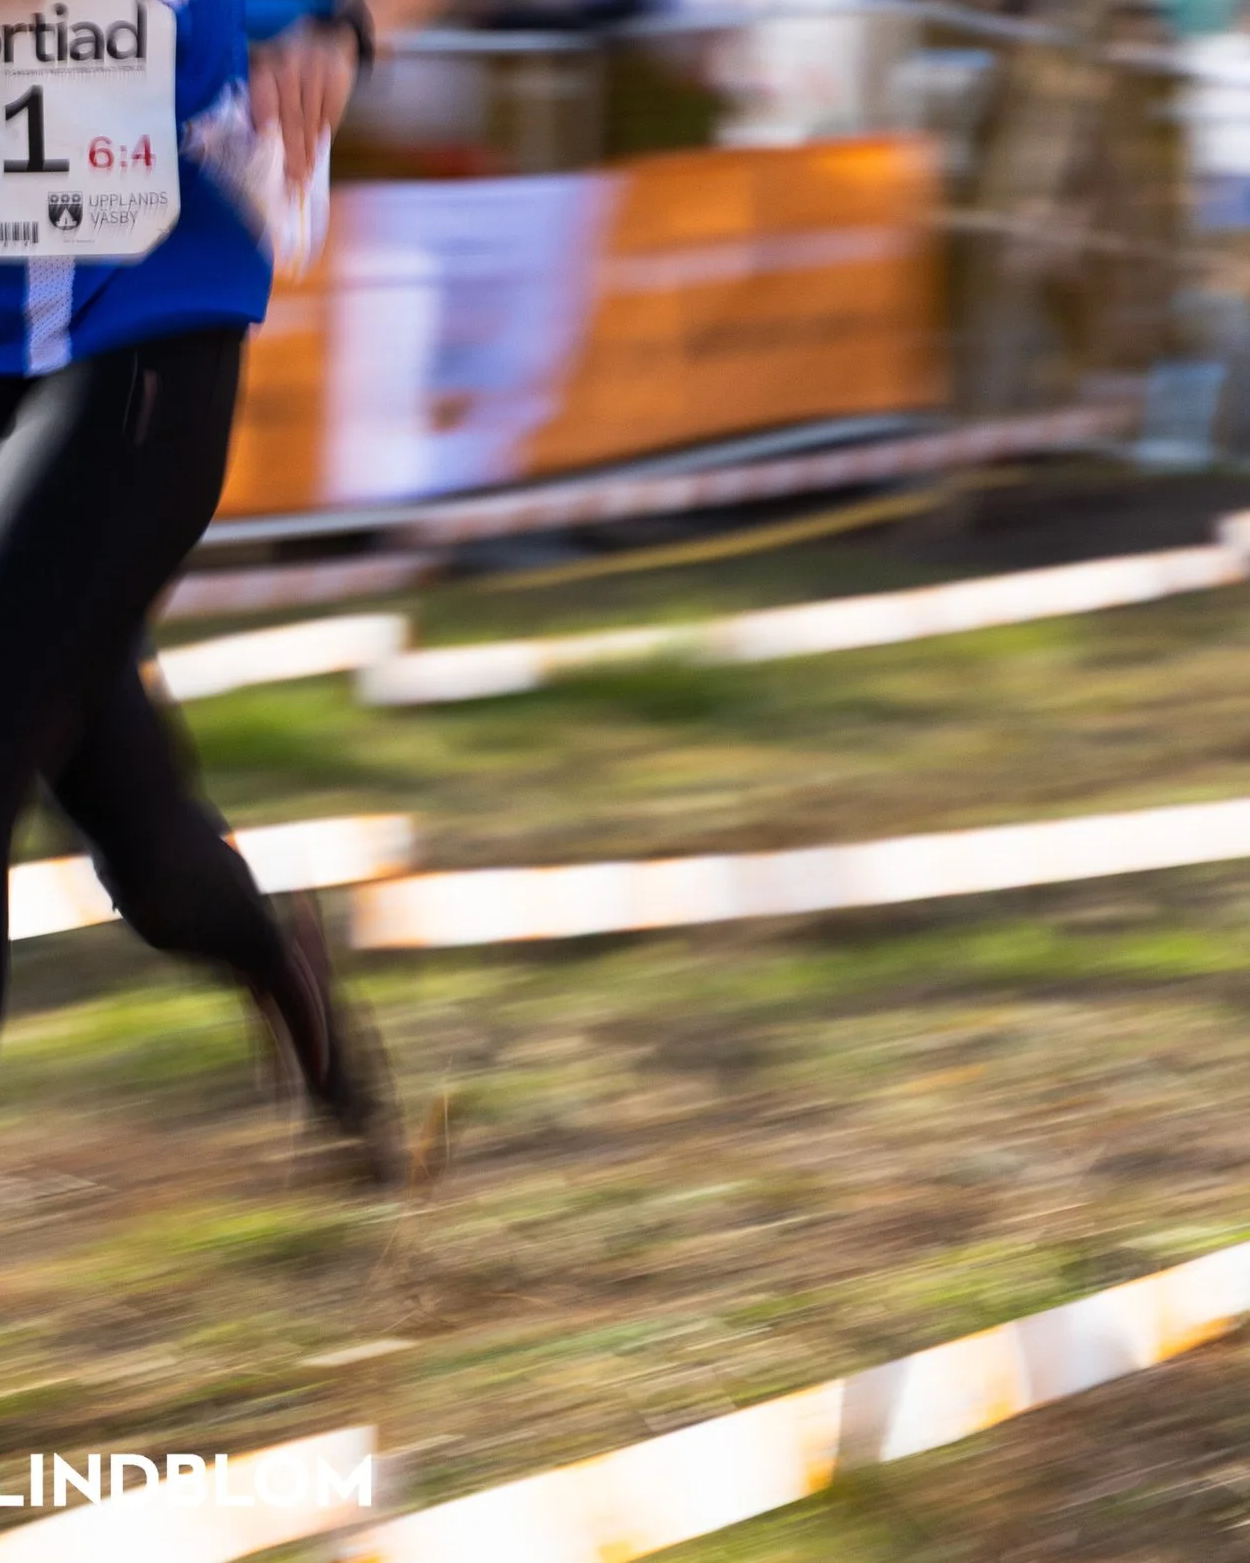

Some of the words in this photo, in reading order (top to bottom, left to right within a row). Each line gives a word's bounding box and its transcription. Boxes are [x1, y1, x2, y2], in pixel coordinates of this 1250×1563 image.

[88, 134, 157, 170] 6:4
[88, 191, 168, 207] UPPLANDS
[90, 208, 138, 225] VÄSBY
